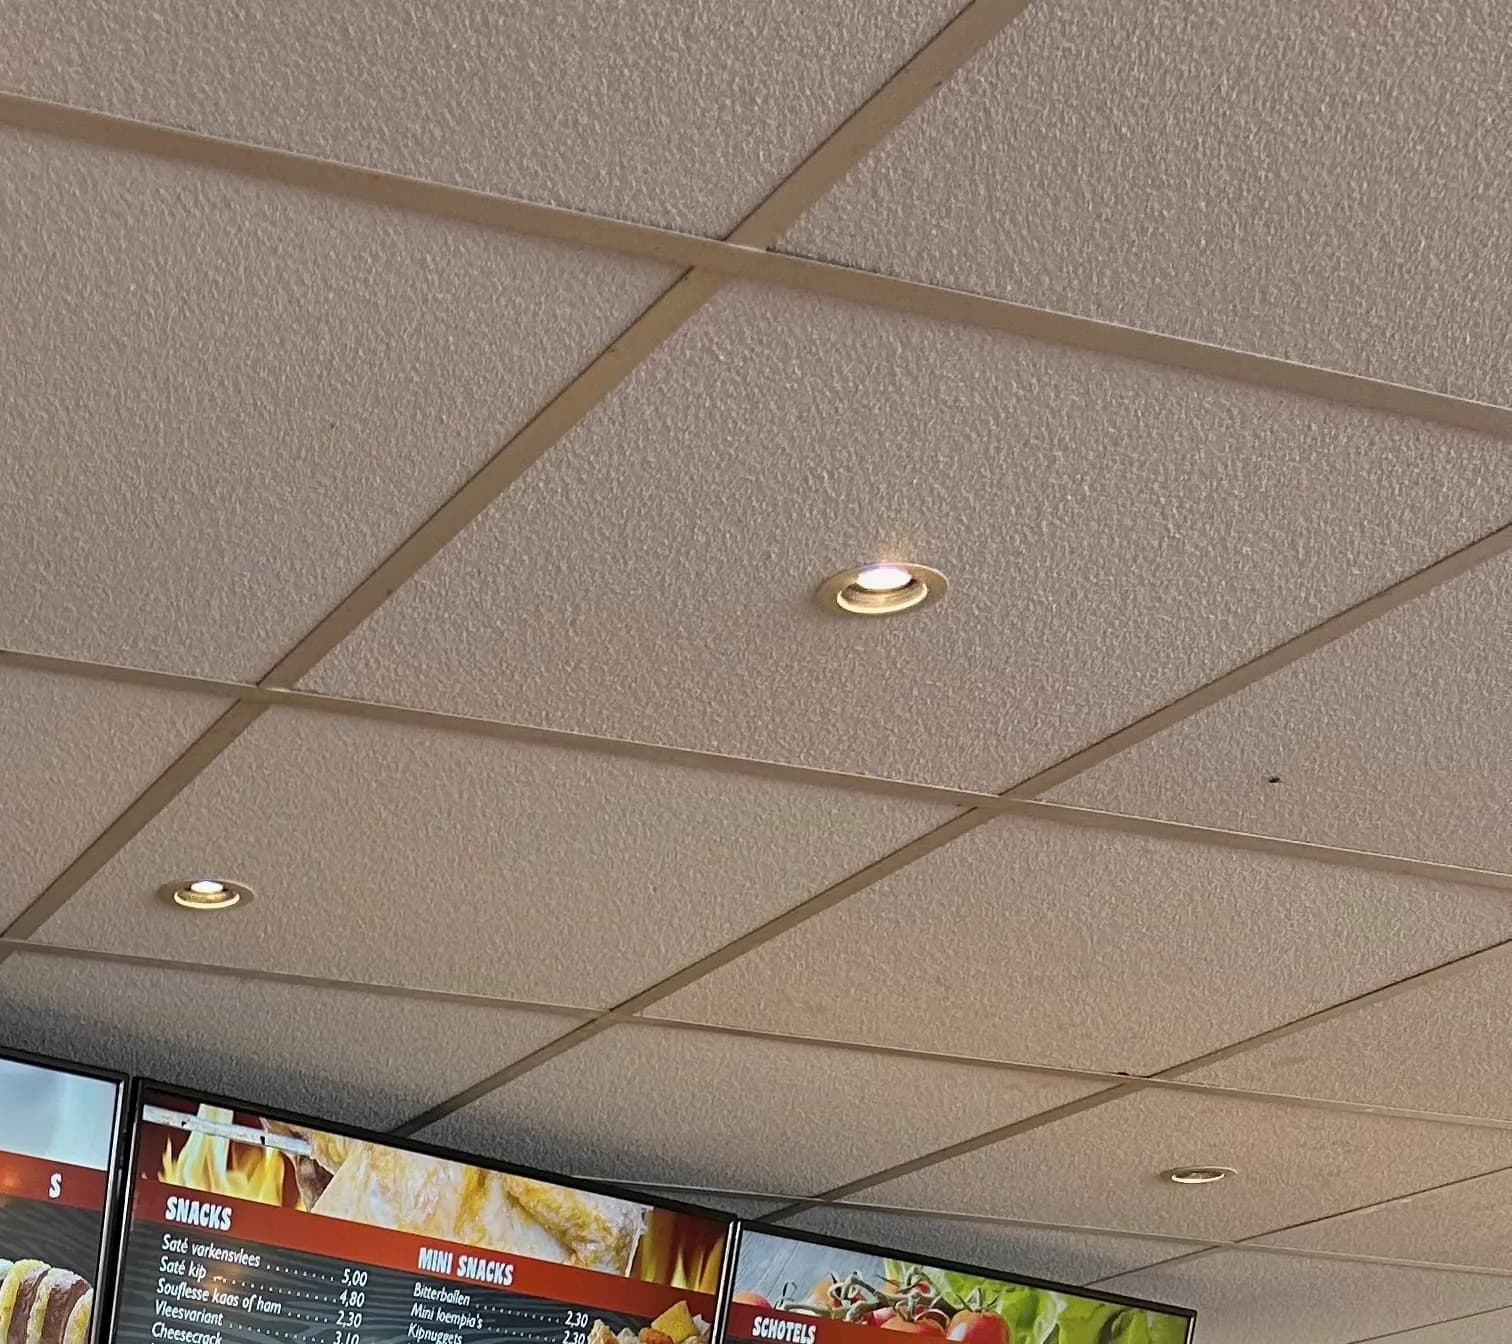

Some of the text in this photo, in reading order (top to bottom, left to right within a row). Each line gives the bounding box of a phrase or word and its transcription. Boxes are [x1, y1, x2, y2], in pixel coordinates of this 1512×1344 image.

[48, 1172, 63, 1199] S
[165, 1196, 232, 1231] SNACKS
[162, 1234, 367, 1287] Saté varkensvlees 5,00
[418, 1247, 513, 1285] MINI SNACKS
[159, 1256, 365, 1307] Saté kip 4,80
[156, 1300, 223, 1326] Vleesvariant
[157, 1278, 362, 1328] Souflesse kaas of ham 2,30
[410, 1302, 434, 1320] Mini
[436, 1308, 483, 1329] loempia's
[413, 1282, 588, 1328] Bitterballen 2,30
[752, 1316, 816, 1344] SCHOTELS
